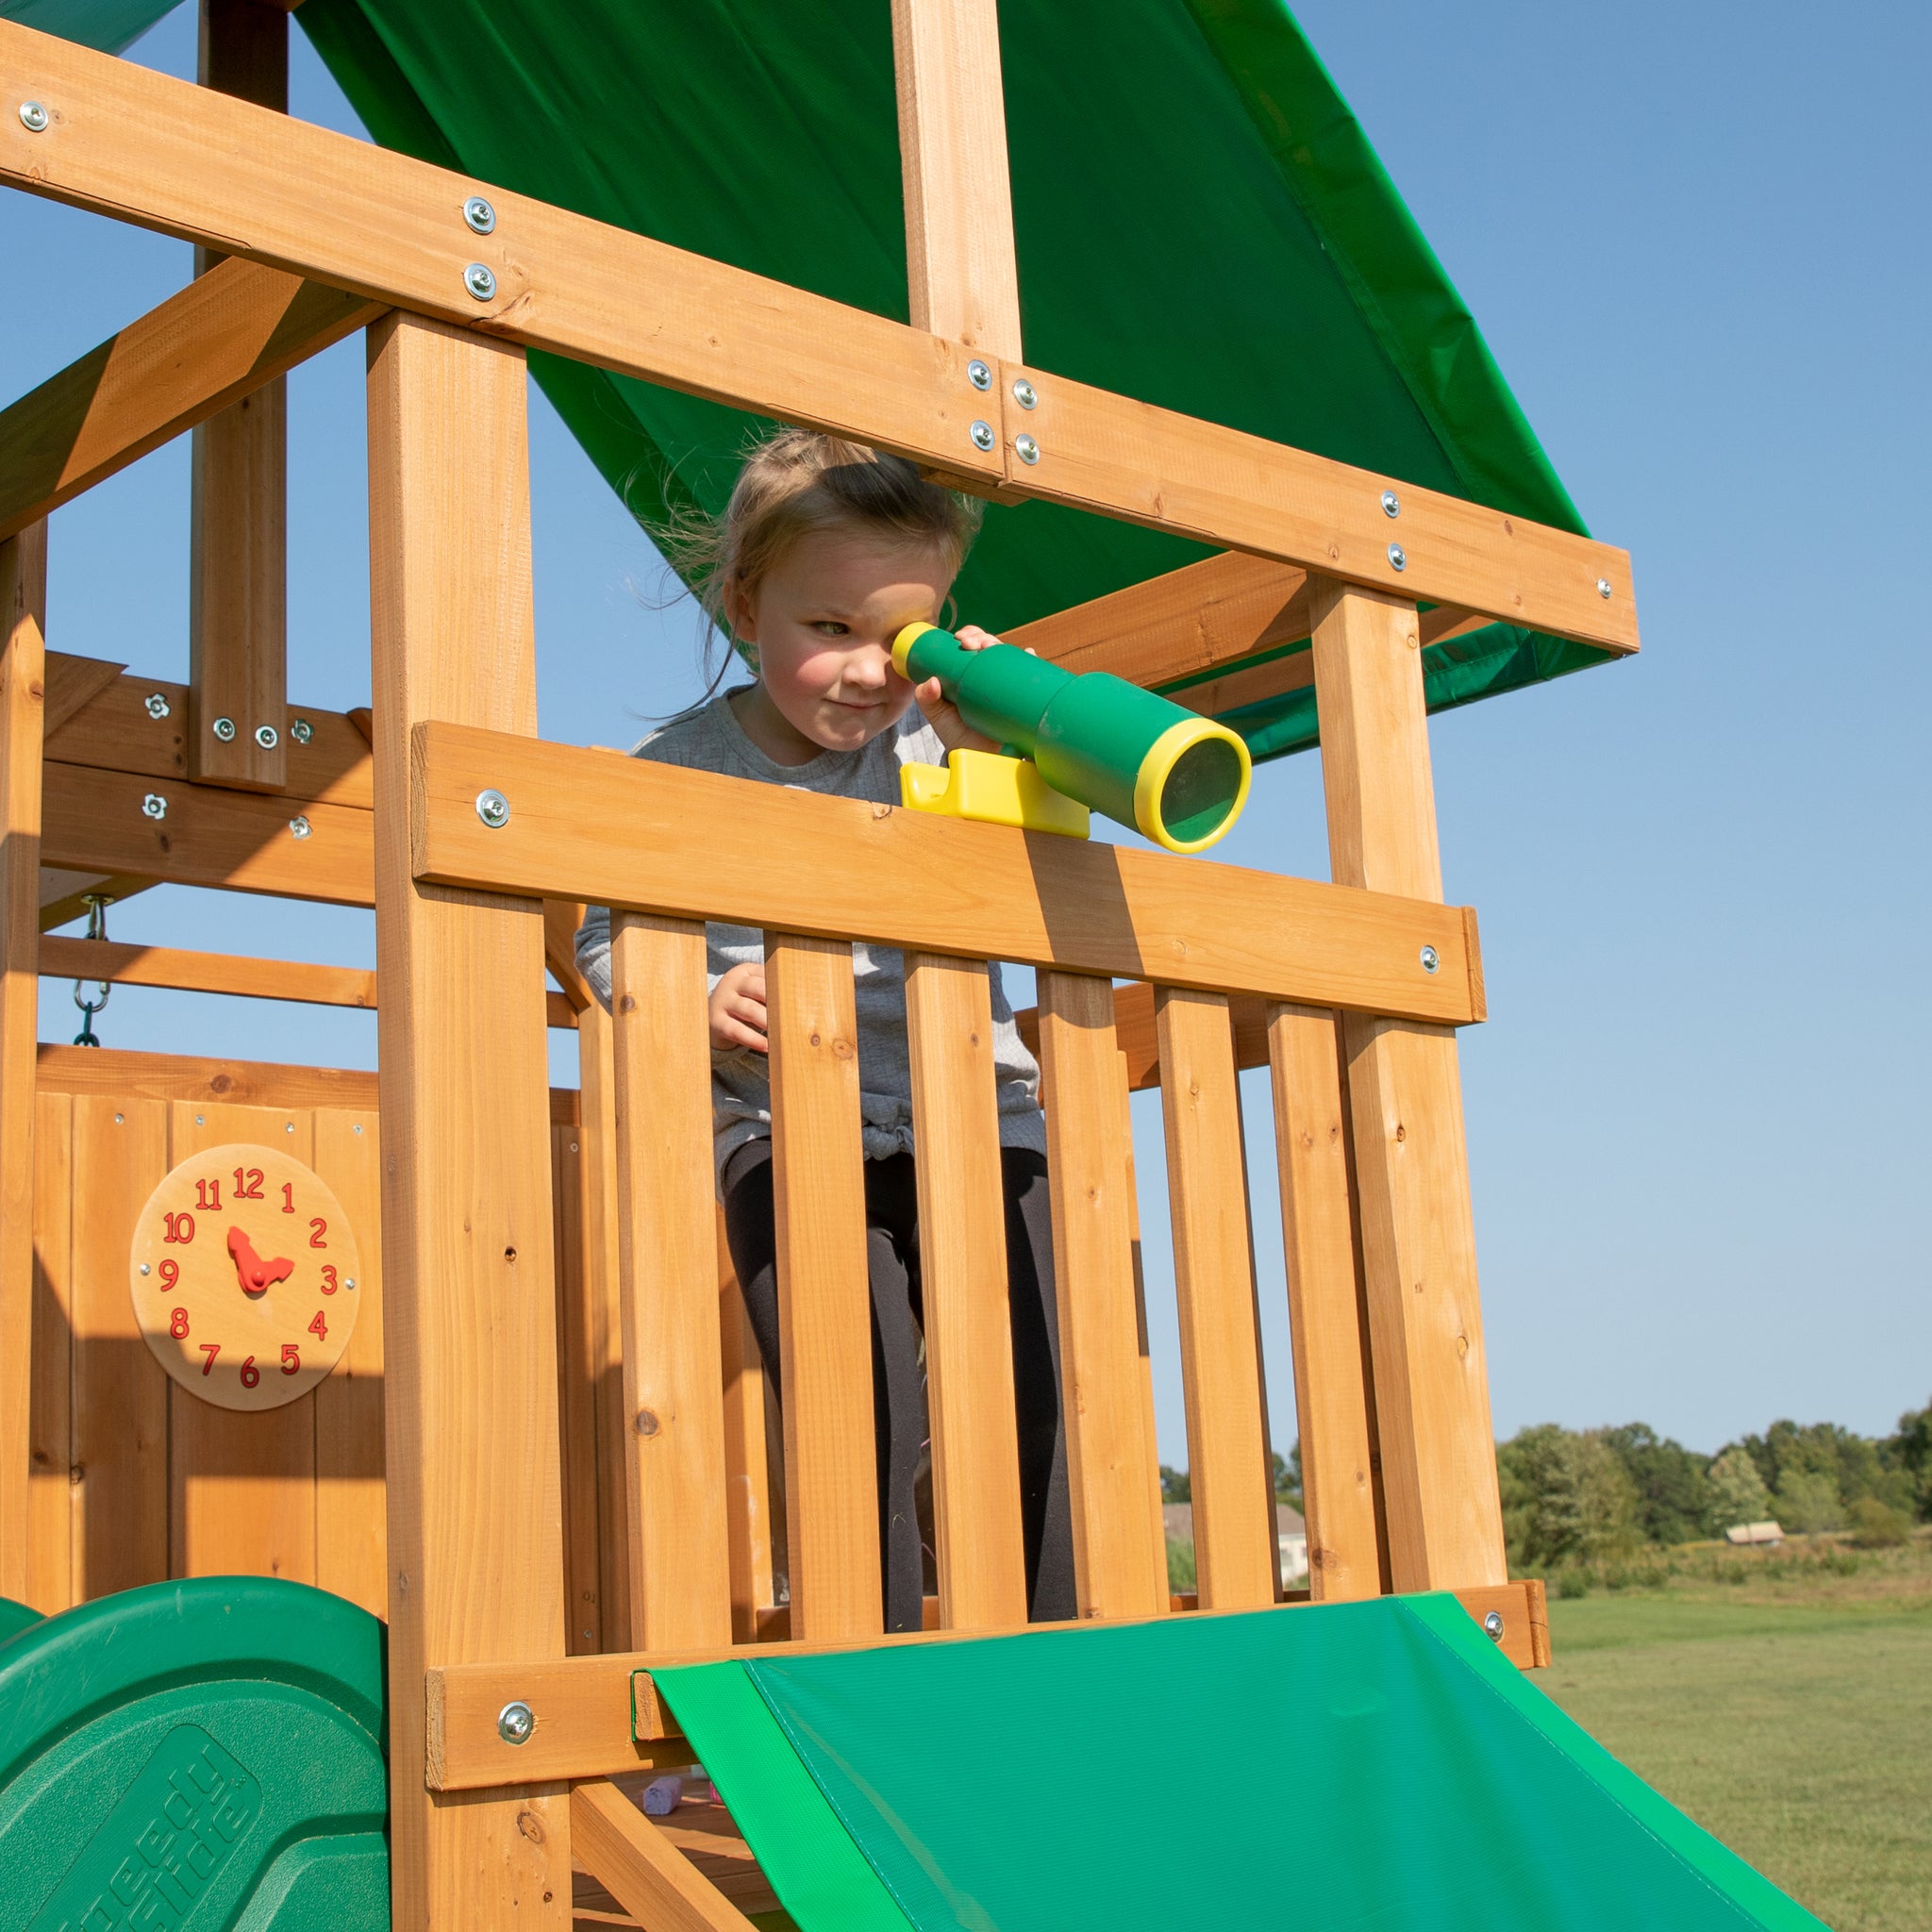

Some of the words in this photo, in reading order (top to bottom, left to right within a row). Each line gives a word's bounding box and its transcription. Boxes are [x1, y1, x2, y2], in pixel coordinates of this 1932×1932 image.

[196, 1179, 222, 1210] 11
[234, 1167, 264, 1199] 12
[282, 1183, 294, 1213] 1
[163, 1212, 194, 1243] 10
[309, 1218, 326, 1248] 2
[158, 1259, 179, 1291] 9
[321, 1265, 337, 1295] 3
[171, 1307, 189, 1340] 8
[308, 1310, 327, 1341] 4
[200, 1344, 221, 1375] 7
[241, 1356, 259, 1388] 6
[281, 1344, 300, 1374] 5
[58, 1743, 233, 1932] peedy
